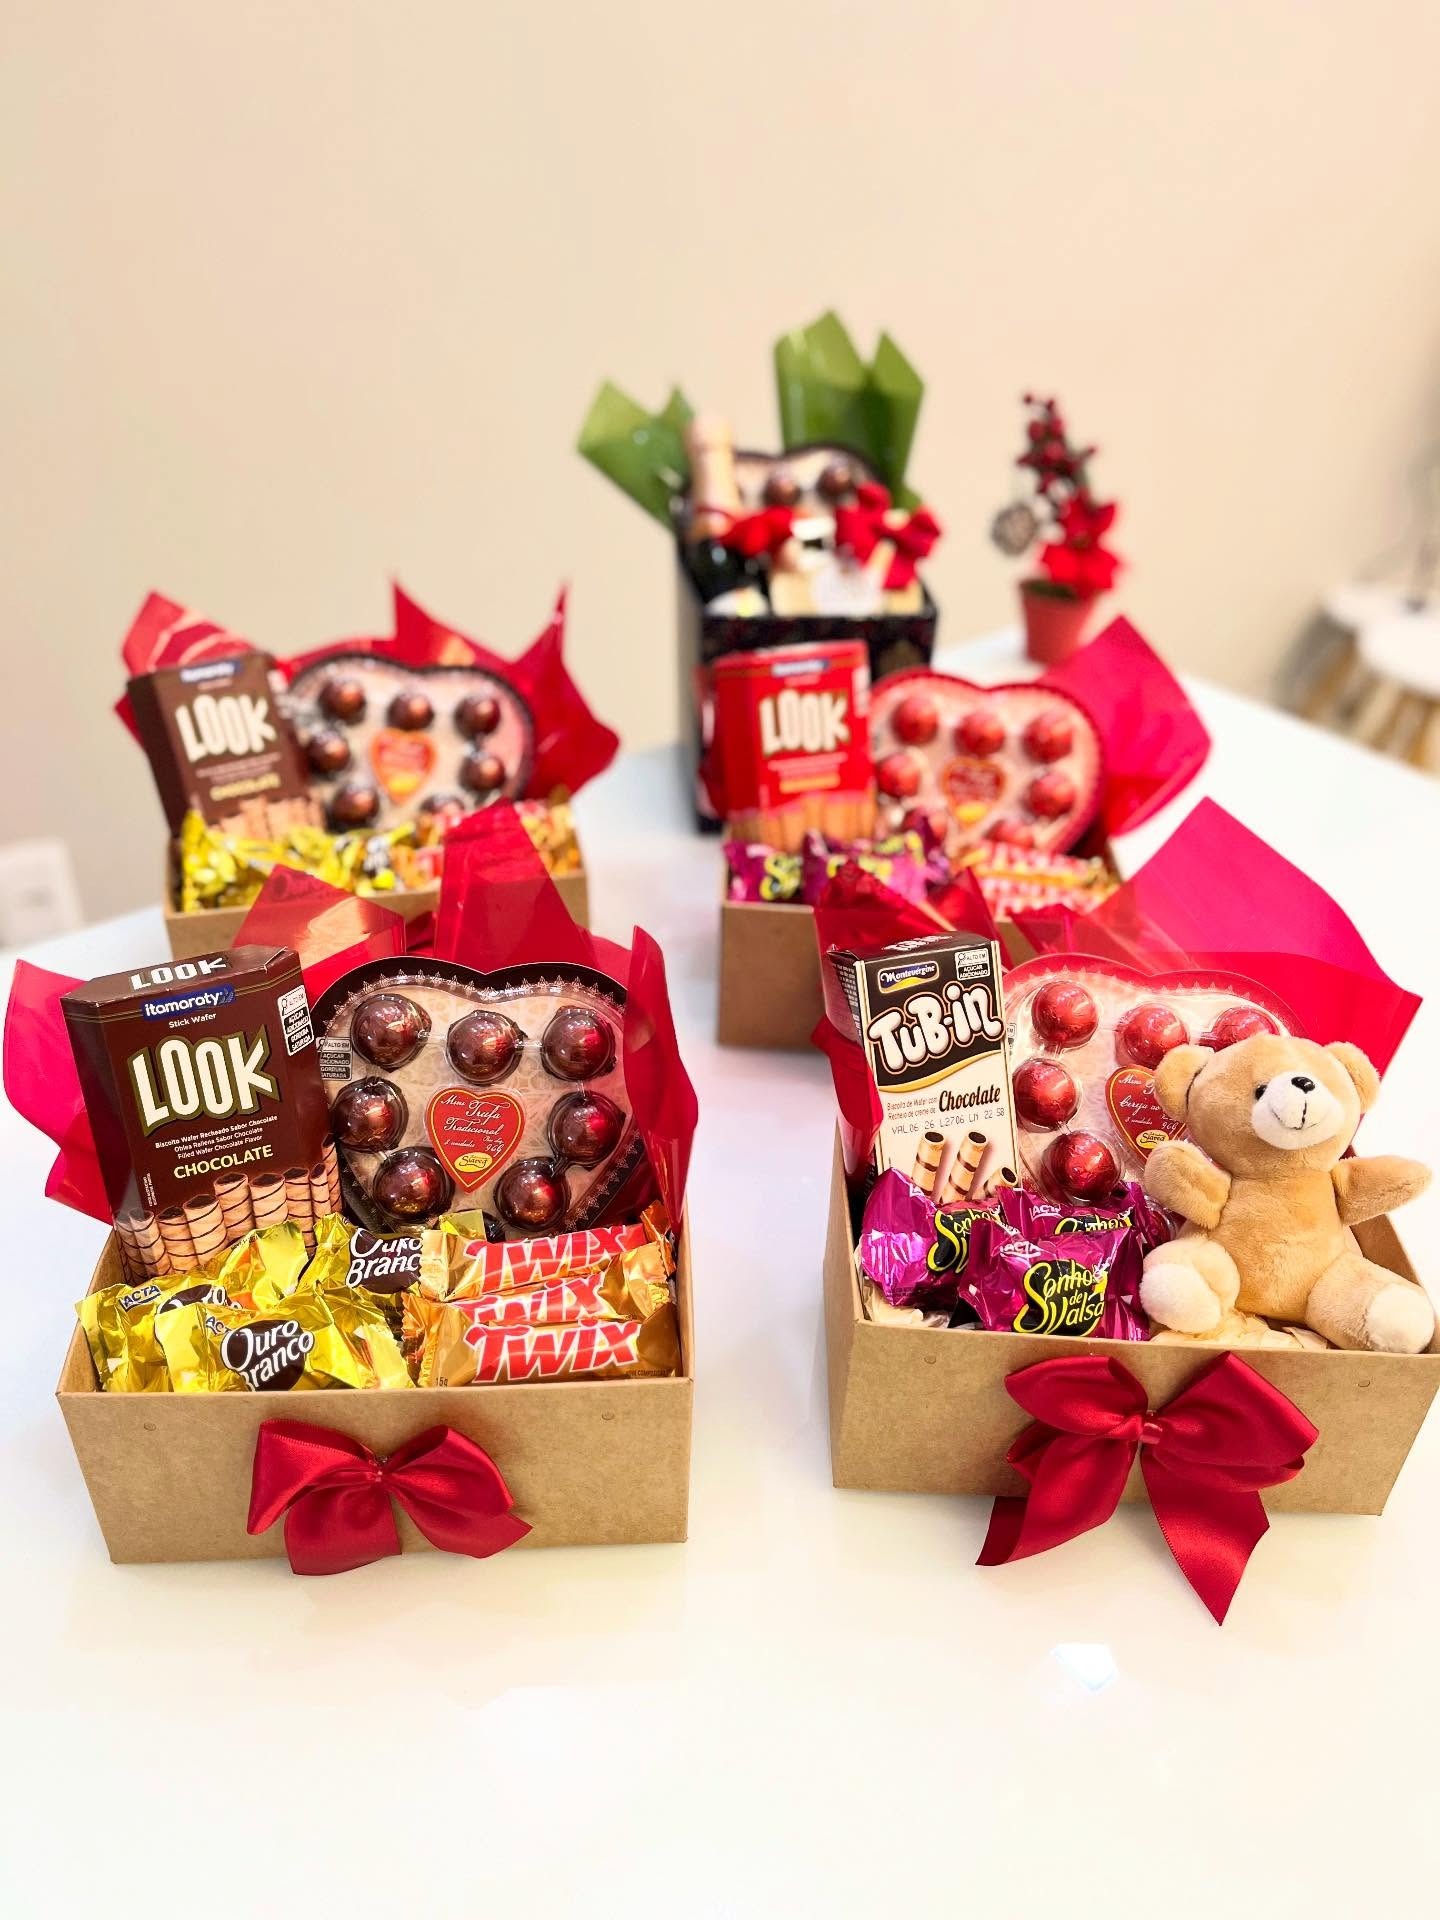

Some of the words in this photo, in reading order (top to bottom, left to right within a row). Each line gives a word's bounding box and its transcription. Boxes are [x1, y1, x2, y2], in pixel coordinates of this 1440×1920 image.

[174, 693, 278, 763] LOOK
[759, 689, 851, 757] LOOK
[131, 957, 226, 990] LOOK
[145, 992, 223, 1016] itamaraty
[169, 1018, 190, 1029] Stick
[191, 1012, 217, 1024] Wafer
[131, 1036, 274, 1129] LOOK
[938, 1084, 1001, 1112] Chocolate
[444, 1117, 504, 1136] Tradicional
[466, 1100, 510, 1125] Trufa
[155, 1138, 180, 1149] Biscoito
[181, 1134, 199, 1143] Wafer
[200, 1127, 230, 1139] Recheado
[230, 1123, 248, 1132] Sabor
[248, 1115, 278, 1127] Chocolate
[178, 1150, 195, 1160] Filled
[196, 1147, 213, 1155] Wafer
[214, 1139, 243, 1151] Chocolate
[245, 1135, 263, 1144] Flavor
[216, 1134, 233, 1143] Sabor
[234, 1127, 263, 1139] Chocolate
[173, 1145, 274, 1179] CHOCOLATE
[1013, 1260, 1094, 1333] Sonho
[1043, 1292, 1105, 1334] Valsa
[1069, 1290, 1083, 1306] de
[221, 1320, 299, 1371] Ouro
